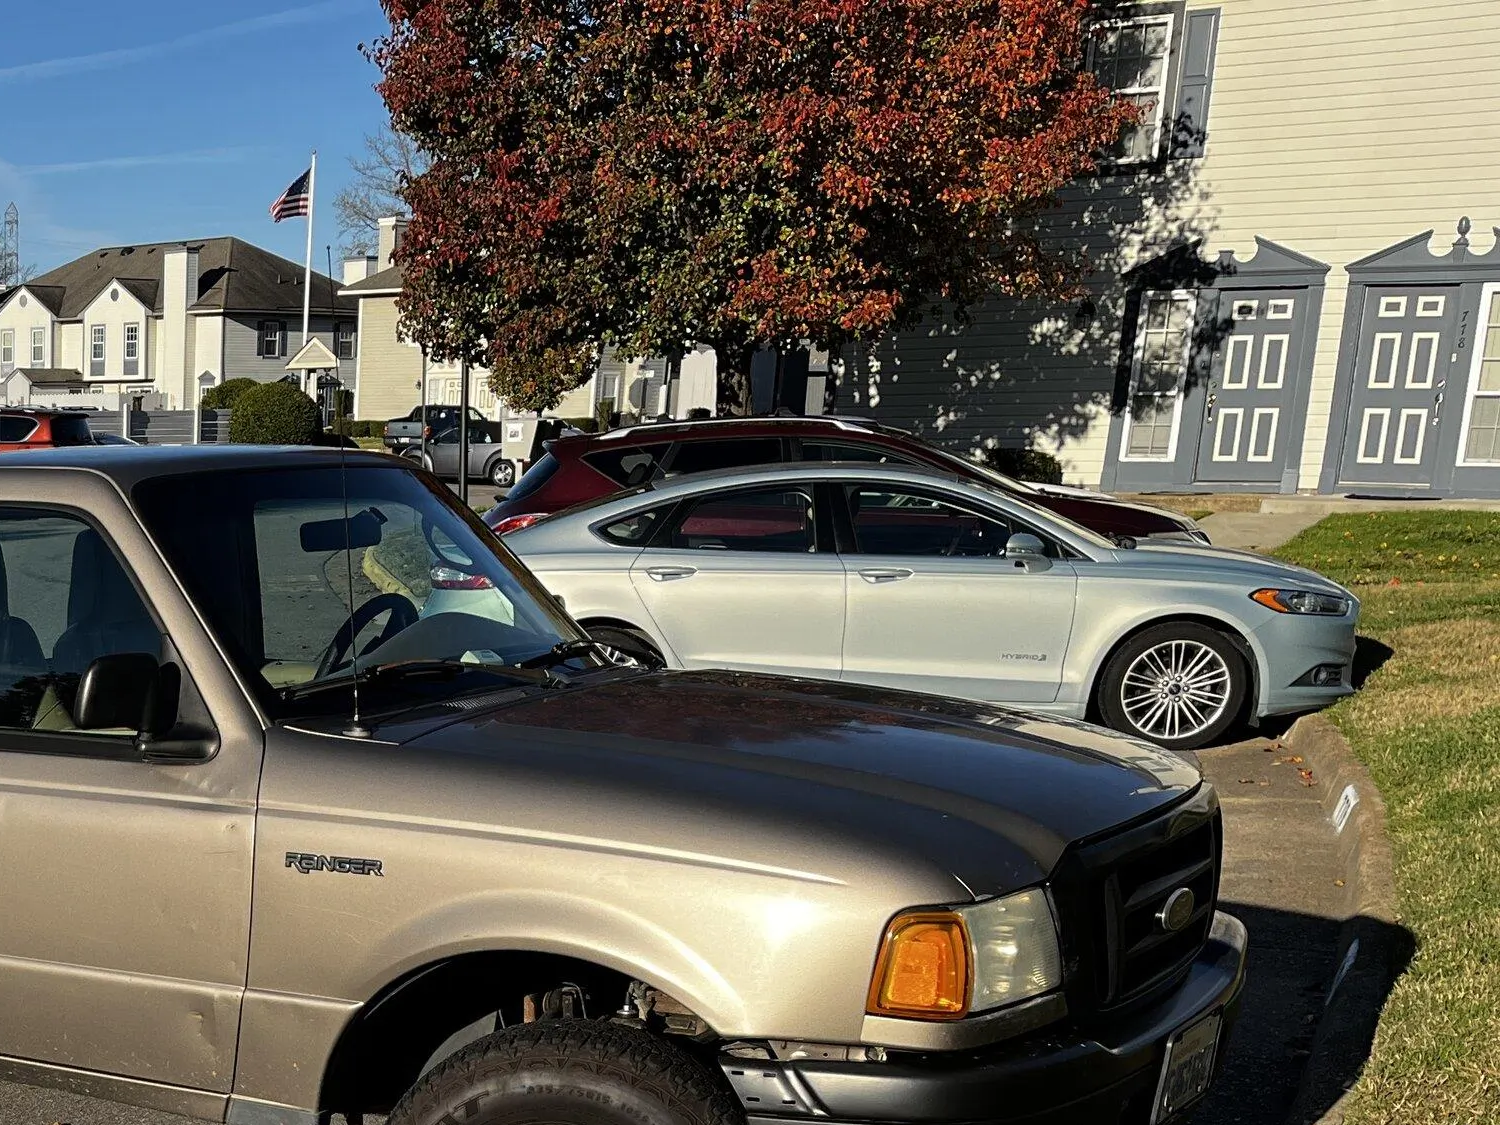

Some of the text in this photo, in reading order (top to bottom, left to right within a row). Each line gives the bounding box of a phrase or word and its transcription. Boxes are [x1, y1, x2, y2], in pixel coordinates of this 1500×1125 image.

[1458, 310, 1470, 349] 778
[1001, 653, 1040, 661] HYBRID
[285, 851, 384, 877] RANGER
